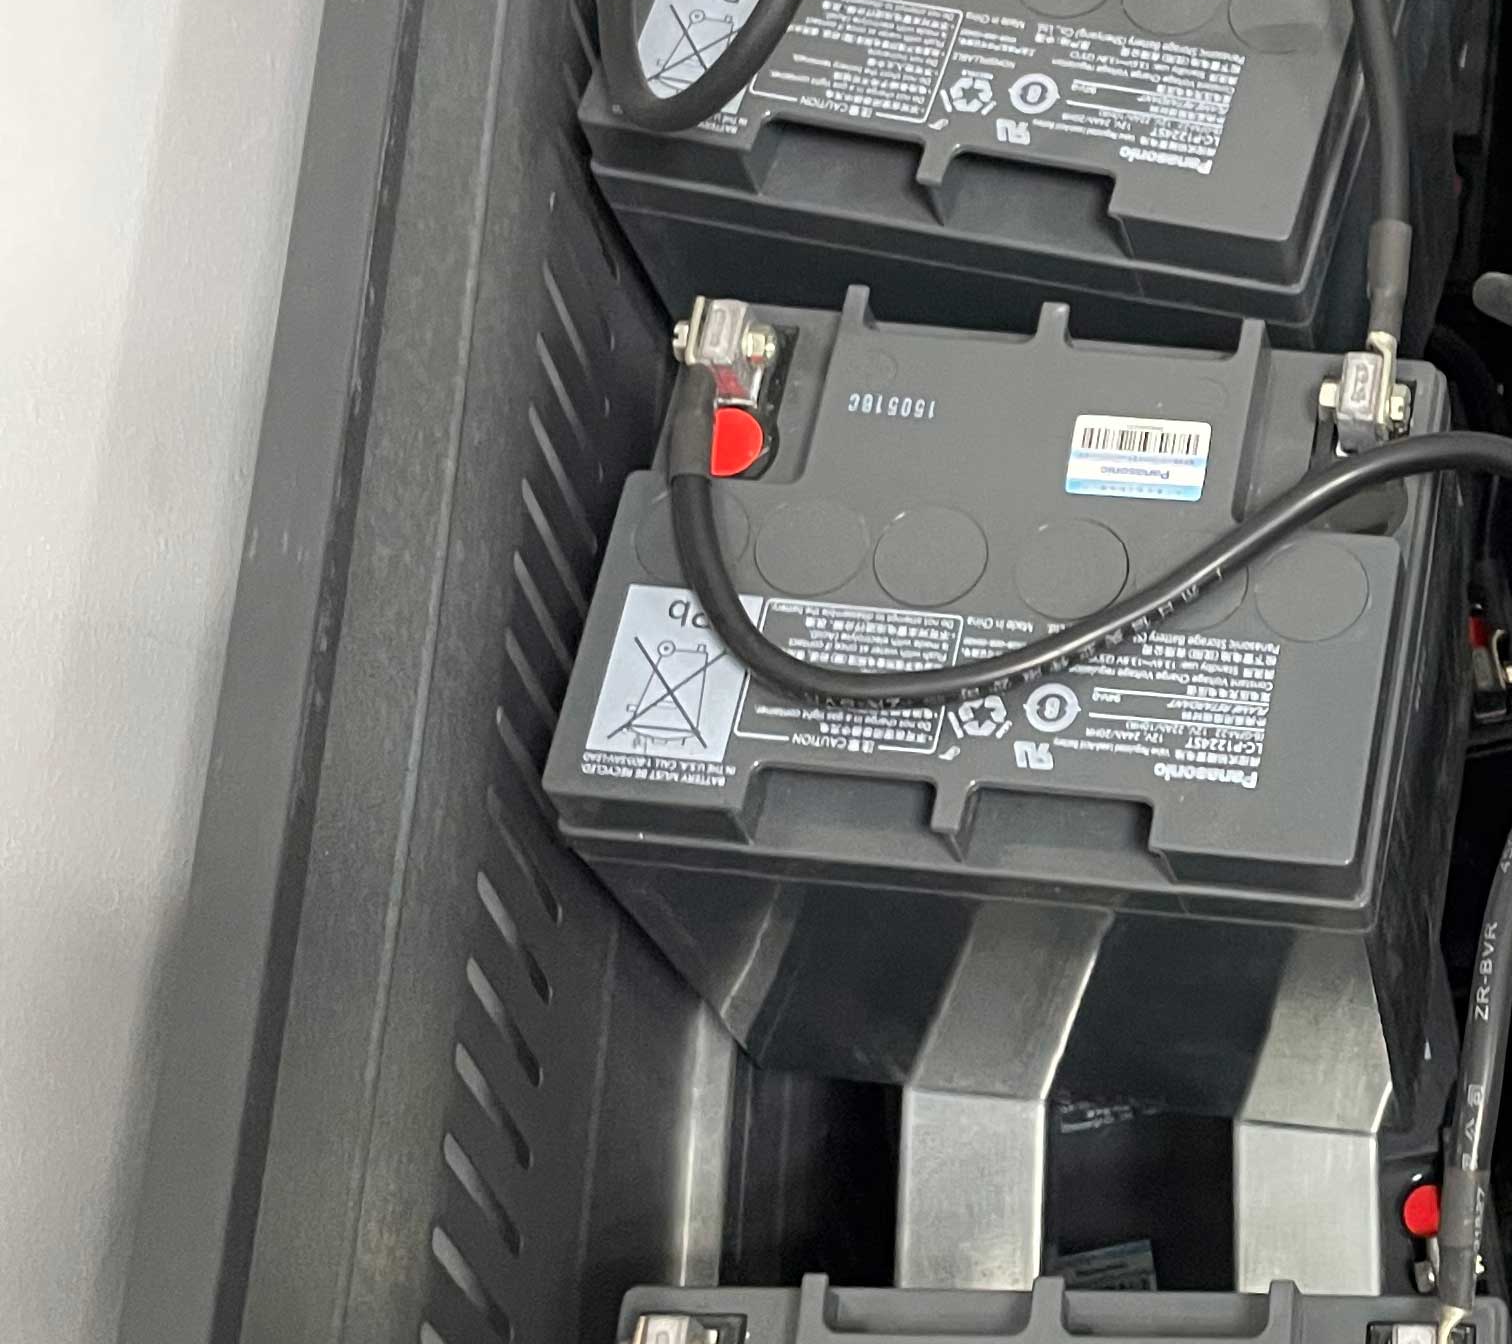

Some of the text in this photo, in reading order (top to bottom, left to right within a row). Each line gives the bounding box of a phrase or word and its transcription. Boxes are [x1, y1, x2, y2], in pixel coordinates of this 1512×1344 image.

[799, 94, 848, 112] CAUTION
[1118, 145, 1212, 174] Panasonic
[1099, 463, 1169, 480] Panasonic
[791, 731, 846, 749] CAUTION
[1185, 734, 1263, 754] LC-P1224ST
[1152, 761, 1257, 788] Panasonic
[1474, 919, 1501, 1023] ZR-BVR
